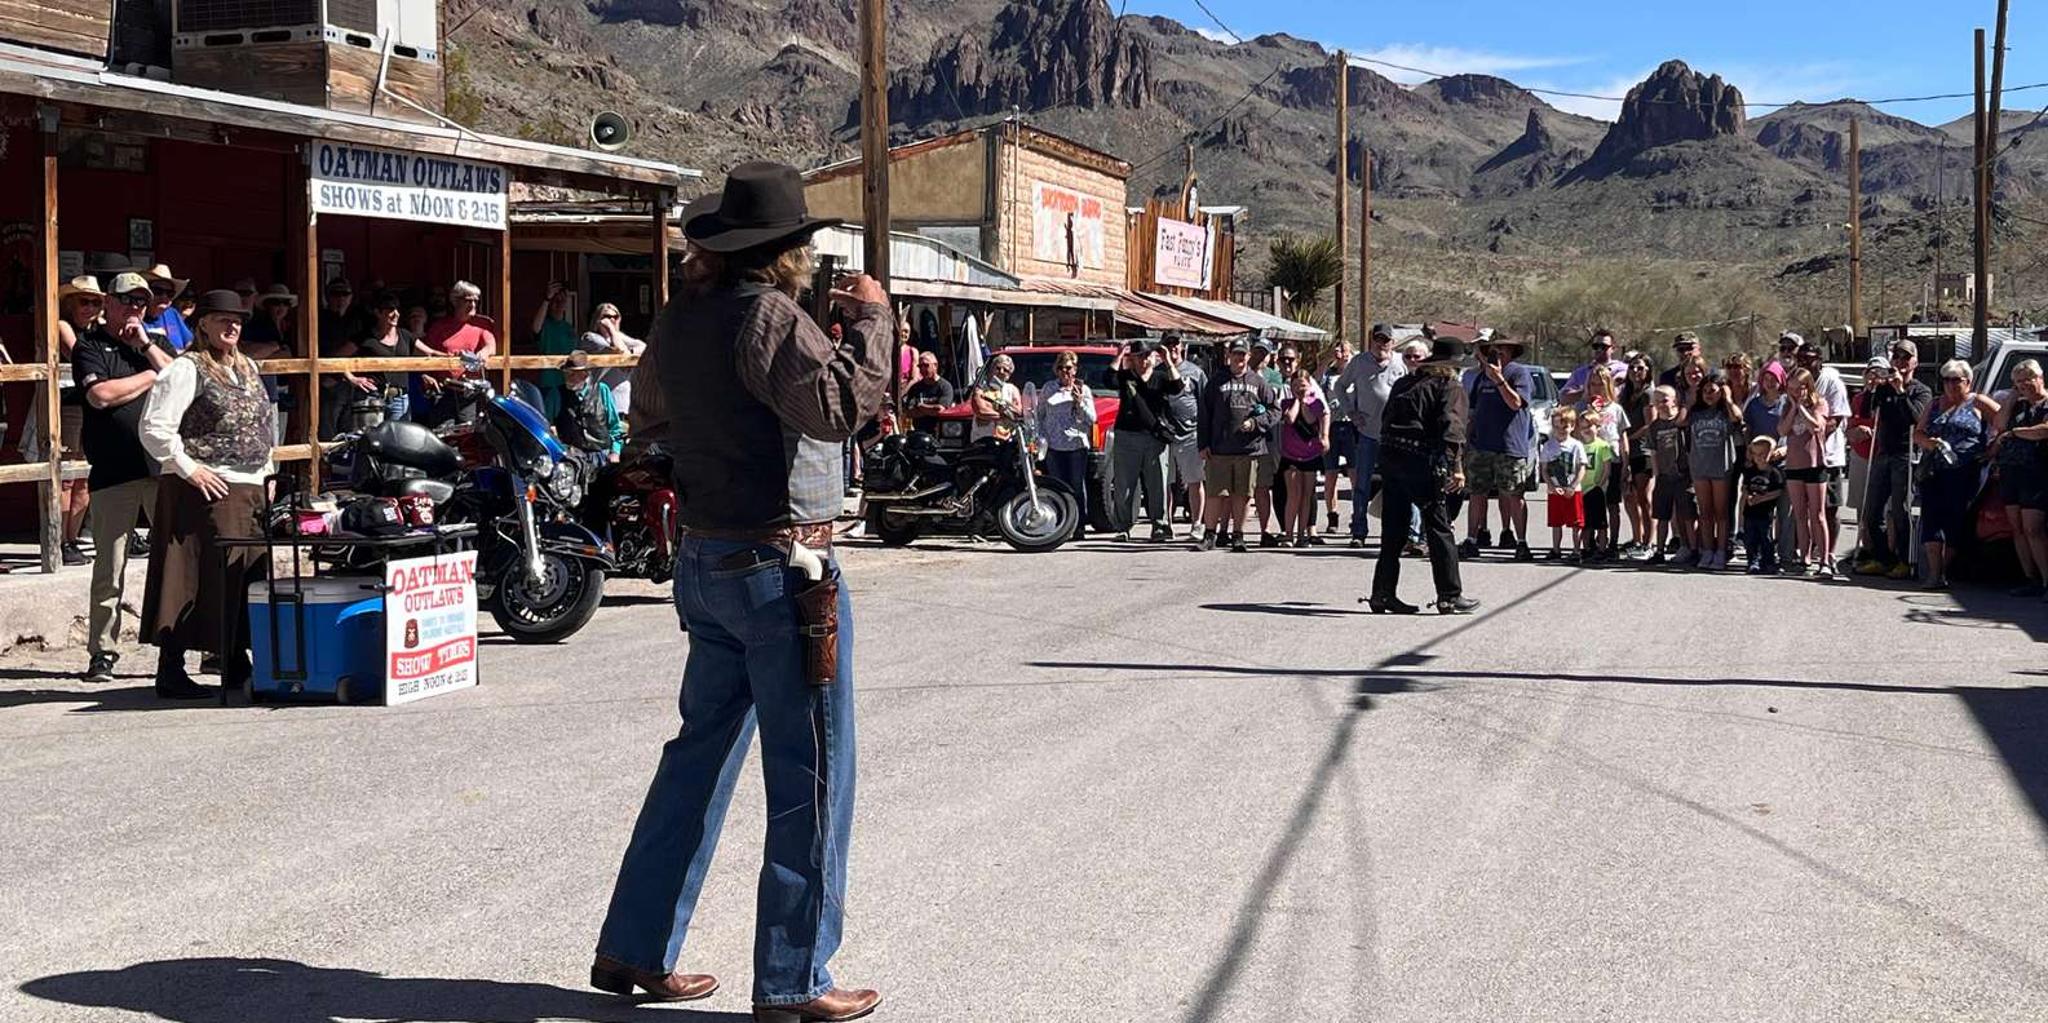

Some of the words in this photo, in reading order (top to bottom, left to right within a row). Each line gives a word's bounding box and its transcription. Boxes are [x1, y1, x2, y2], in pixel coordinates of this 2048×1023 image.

[320, 144, 408, 184] OATMAN
[413, 157, 500, 194] OUTLAWS
[320, 184, 382, 212] SHOWS
[387, 191, 402, 214] at
[409, 193, 453, 218] NOON
[471, 201, 500, 223] 2:15
[391, 560, 474, 595] OATMAN
[404, 586, 464, 613] OUTLAWS
[396, 653, 432, 675] SHOW
